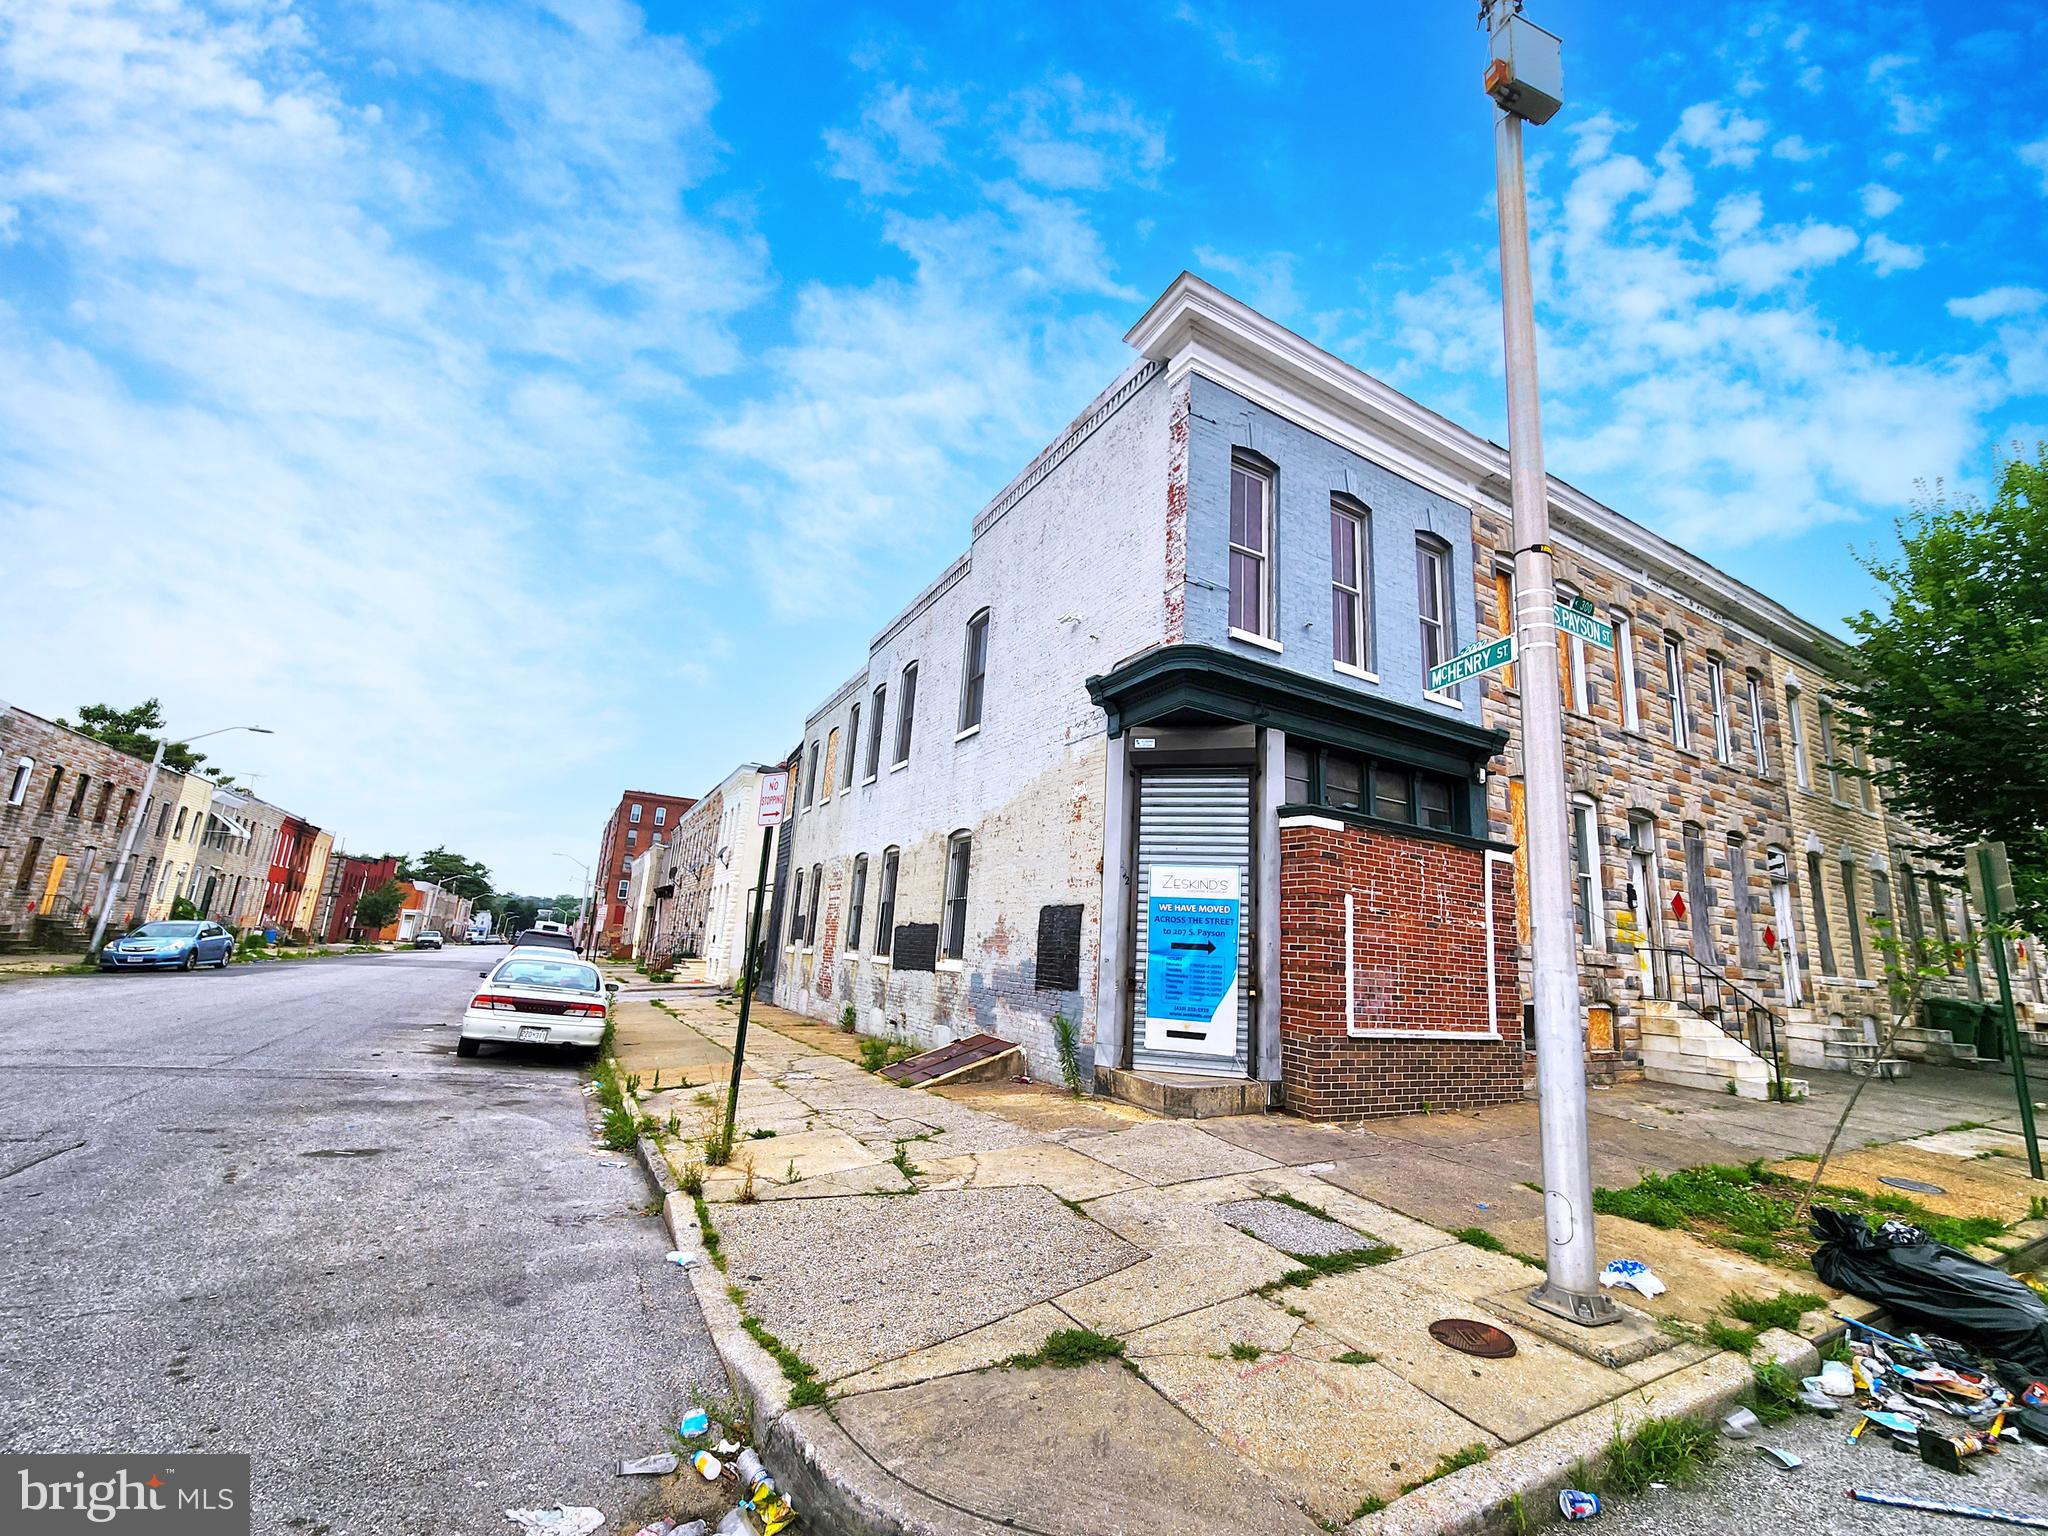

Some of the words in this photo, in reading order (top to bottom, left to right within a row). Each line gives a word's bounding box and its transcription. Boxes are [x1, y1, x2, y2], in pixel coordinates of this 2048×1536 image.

[1579, 600, 1593, 614] 300
[1602, 630, 1610, 643] ST
[1496, 644, 1508, 659] ST
[769, 781, 779, 791] NO
[760, 794, 784, 806] STOPPING
[1158, 903, 1173, 912] WE
[1174, 904, 1197, 912] HAVE
[1198, 905, 1231, 914] MOVED
[1154, 915, 1186, 924] ACROSS
[1188, 916, 1203, 925] THE
[1204, 917, 1235, 926] STREET
[1172, 929, 1187, 937] 207
[1197, 928, 1226, 938] Payson
